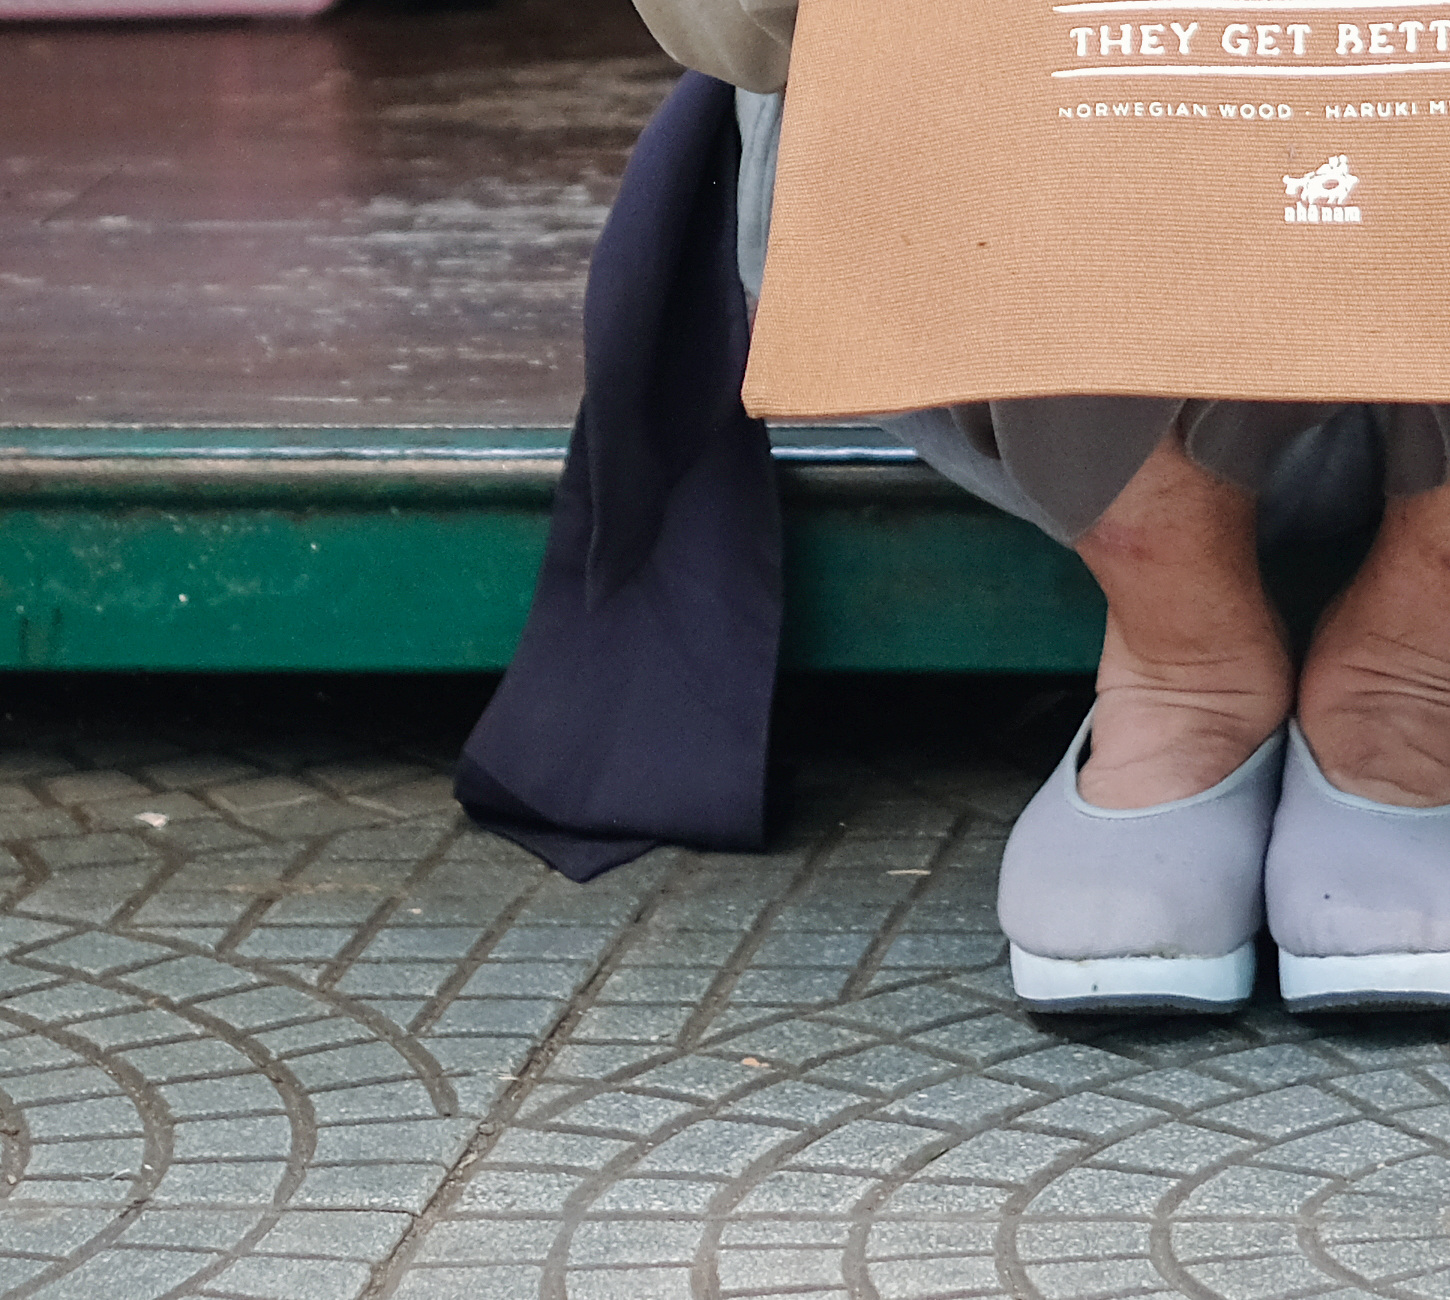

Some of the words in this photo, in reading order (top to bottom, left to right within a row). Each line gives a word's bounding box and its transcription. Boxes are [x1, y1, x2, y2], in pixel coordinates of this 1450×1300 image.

[1069, 22, 1200, 58] THEY
[1222, 22, 1313, 57] GET
[1058, 103, 1209, 119] NORWEGIAN
[1218, 103, 1293, 119] WOOD
[1325, 100, 1418, 119] HARUKI
